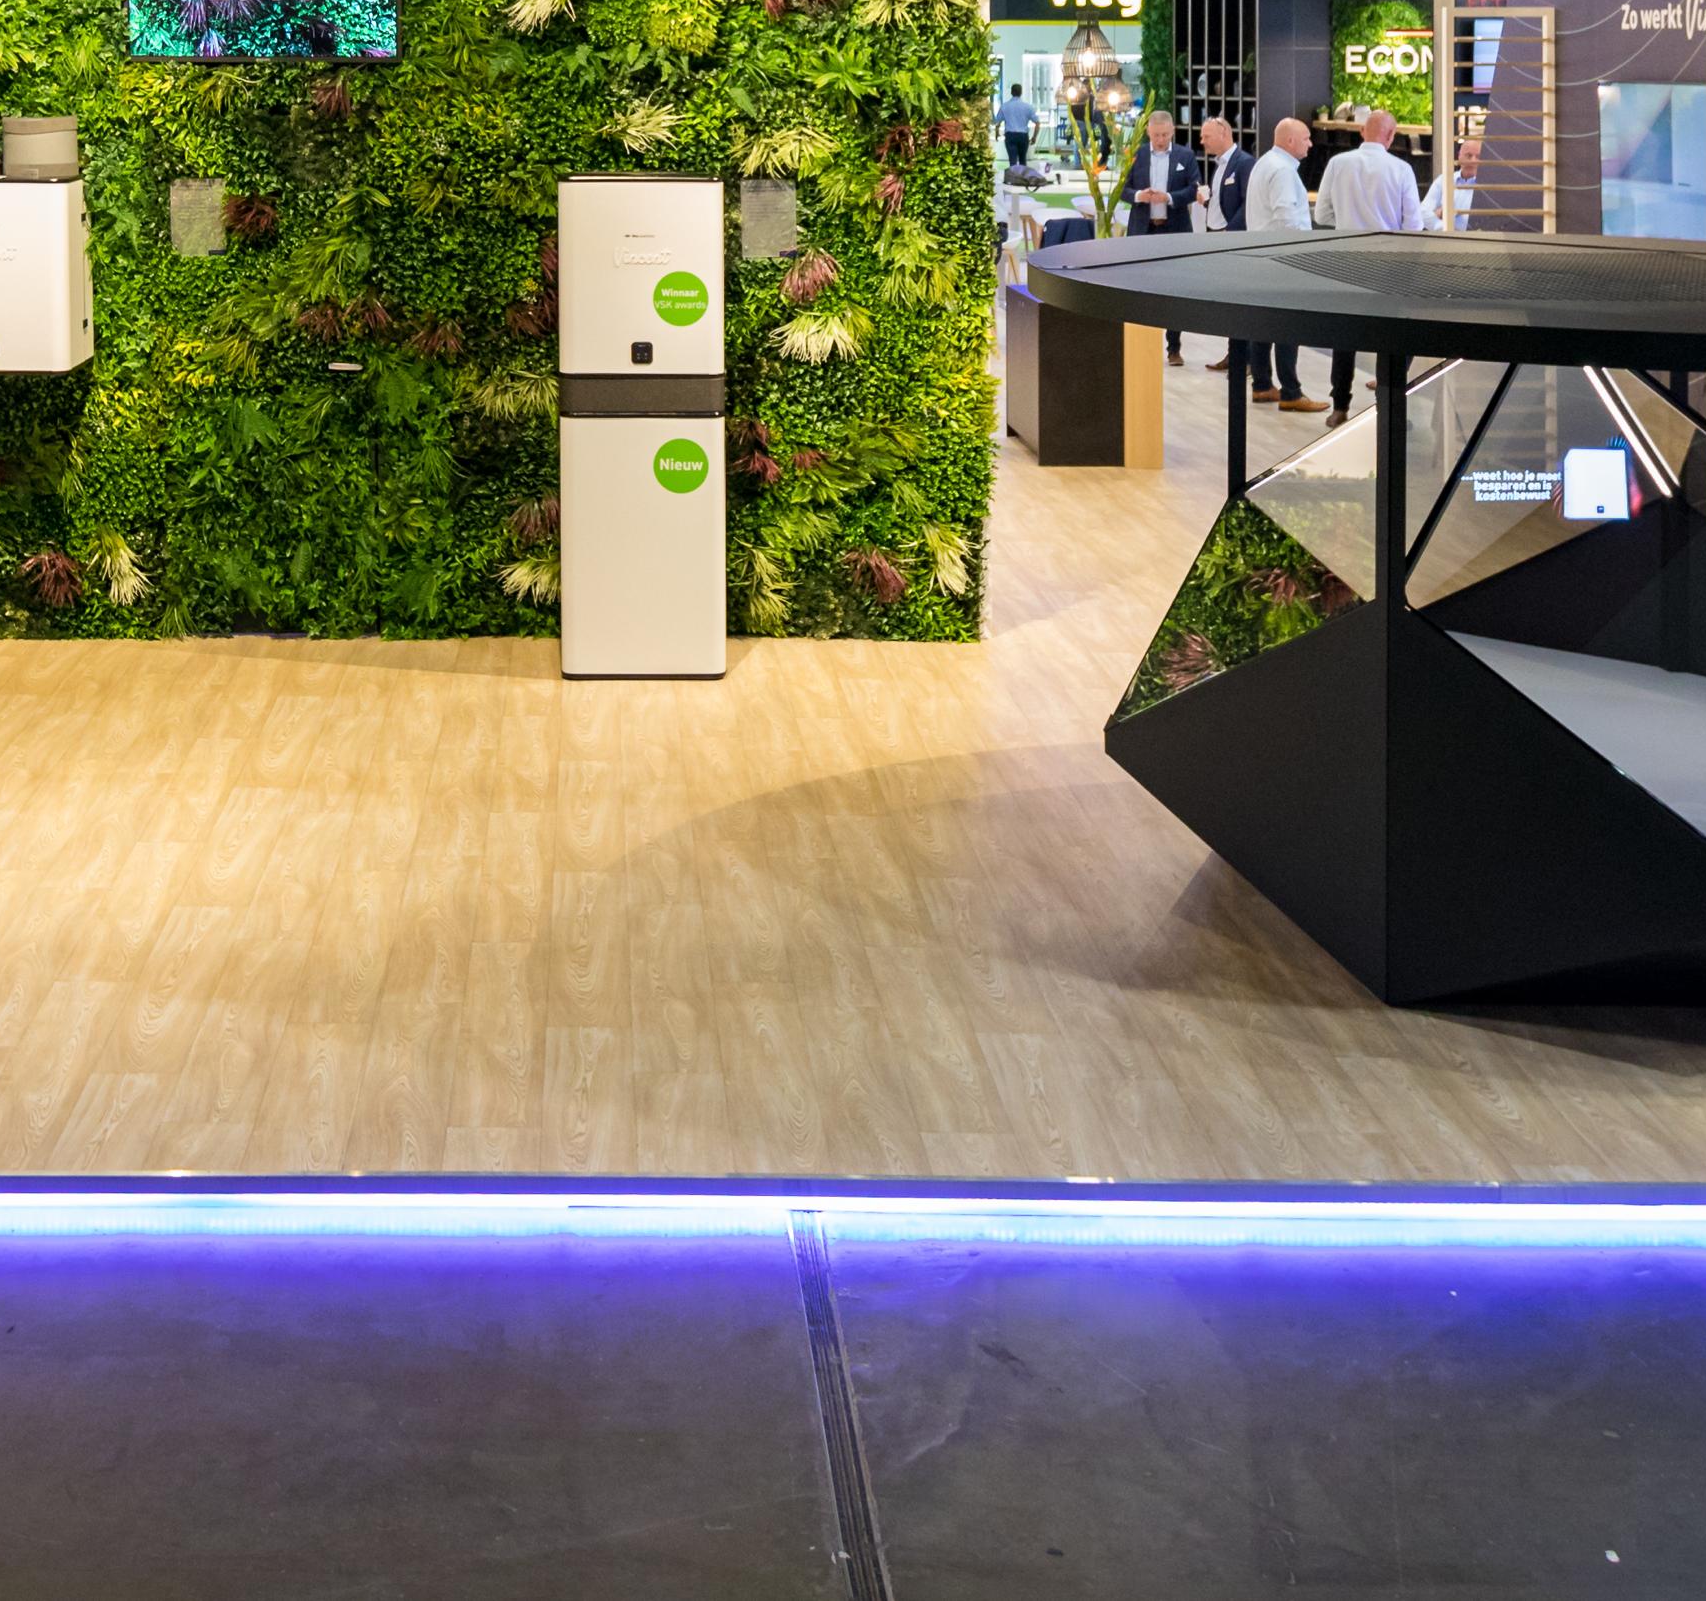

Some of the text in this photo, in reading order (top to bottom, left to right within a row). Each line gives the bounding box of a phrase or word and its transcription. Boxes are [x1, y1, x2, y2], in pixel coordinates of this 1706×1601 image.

[1621, 4, 1638, 30] Zo
[1640, 2, 1682, 30] werkt
[661, 288, 700, 298] Winnaar
[675, 300, 706, 309] awards
[659, 458, 704, 471] Nieuw
[1503, 470, 1523, 481] hoe
[1525, 470, 1535, 483] je
[1474, 481, 1552, 493] besparen en is
[1475, 491, 1551, 501] kostenbewust
